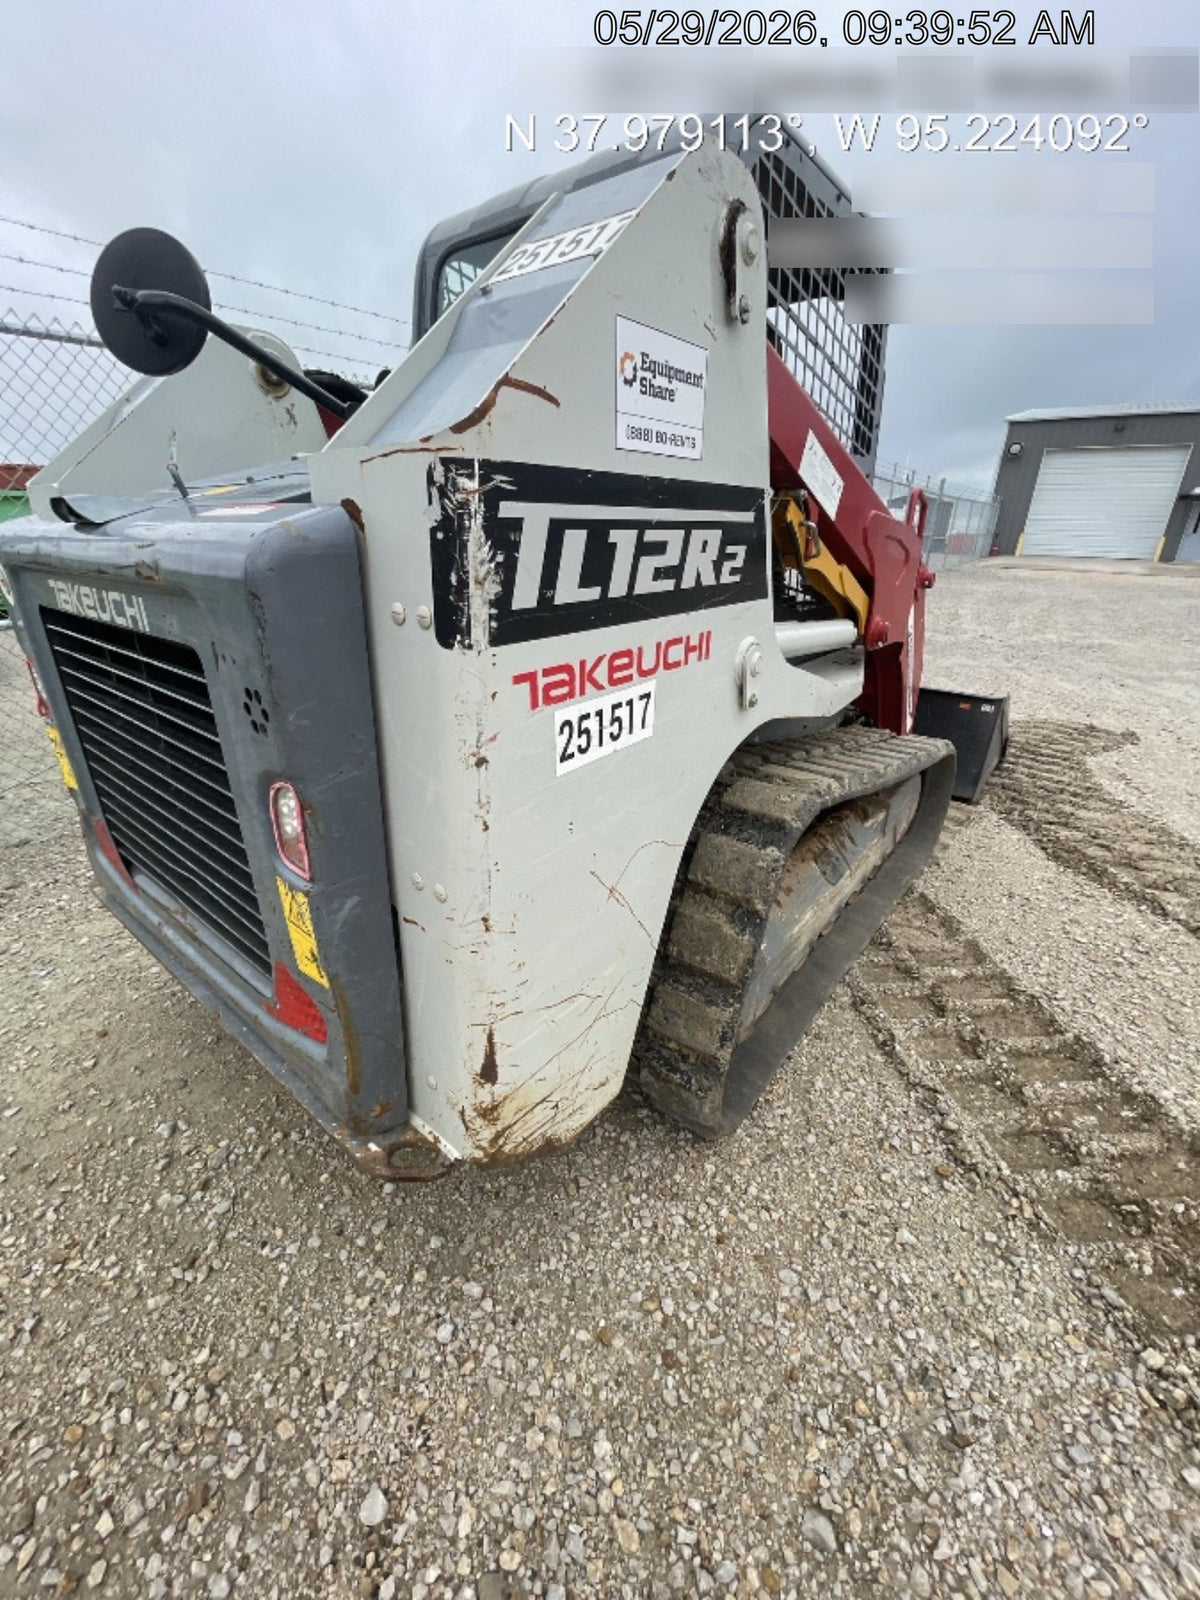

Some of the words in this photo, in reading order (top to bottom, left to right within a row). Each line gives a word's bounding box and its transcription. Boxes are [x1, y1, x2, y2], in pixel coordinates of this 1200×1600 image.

[496, 214, 633, 277] 251517
[640, 352, 704, 389] Equipment
[640, 376, 675, 402] Share
[558, 691, 652, 764] 251517
